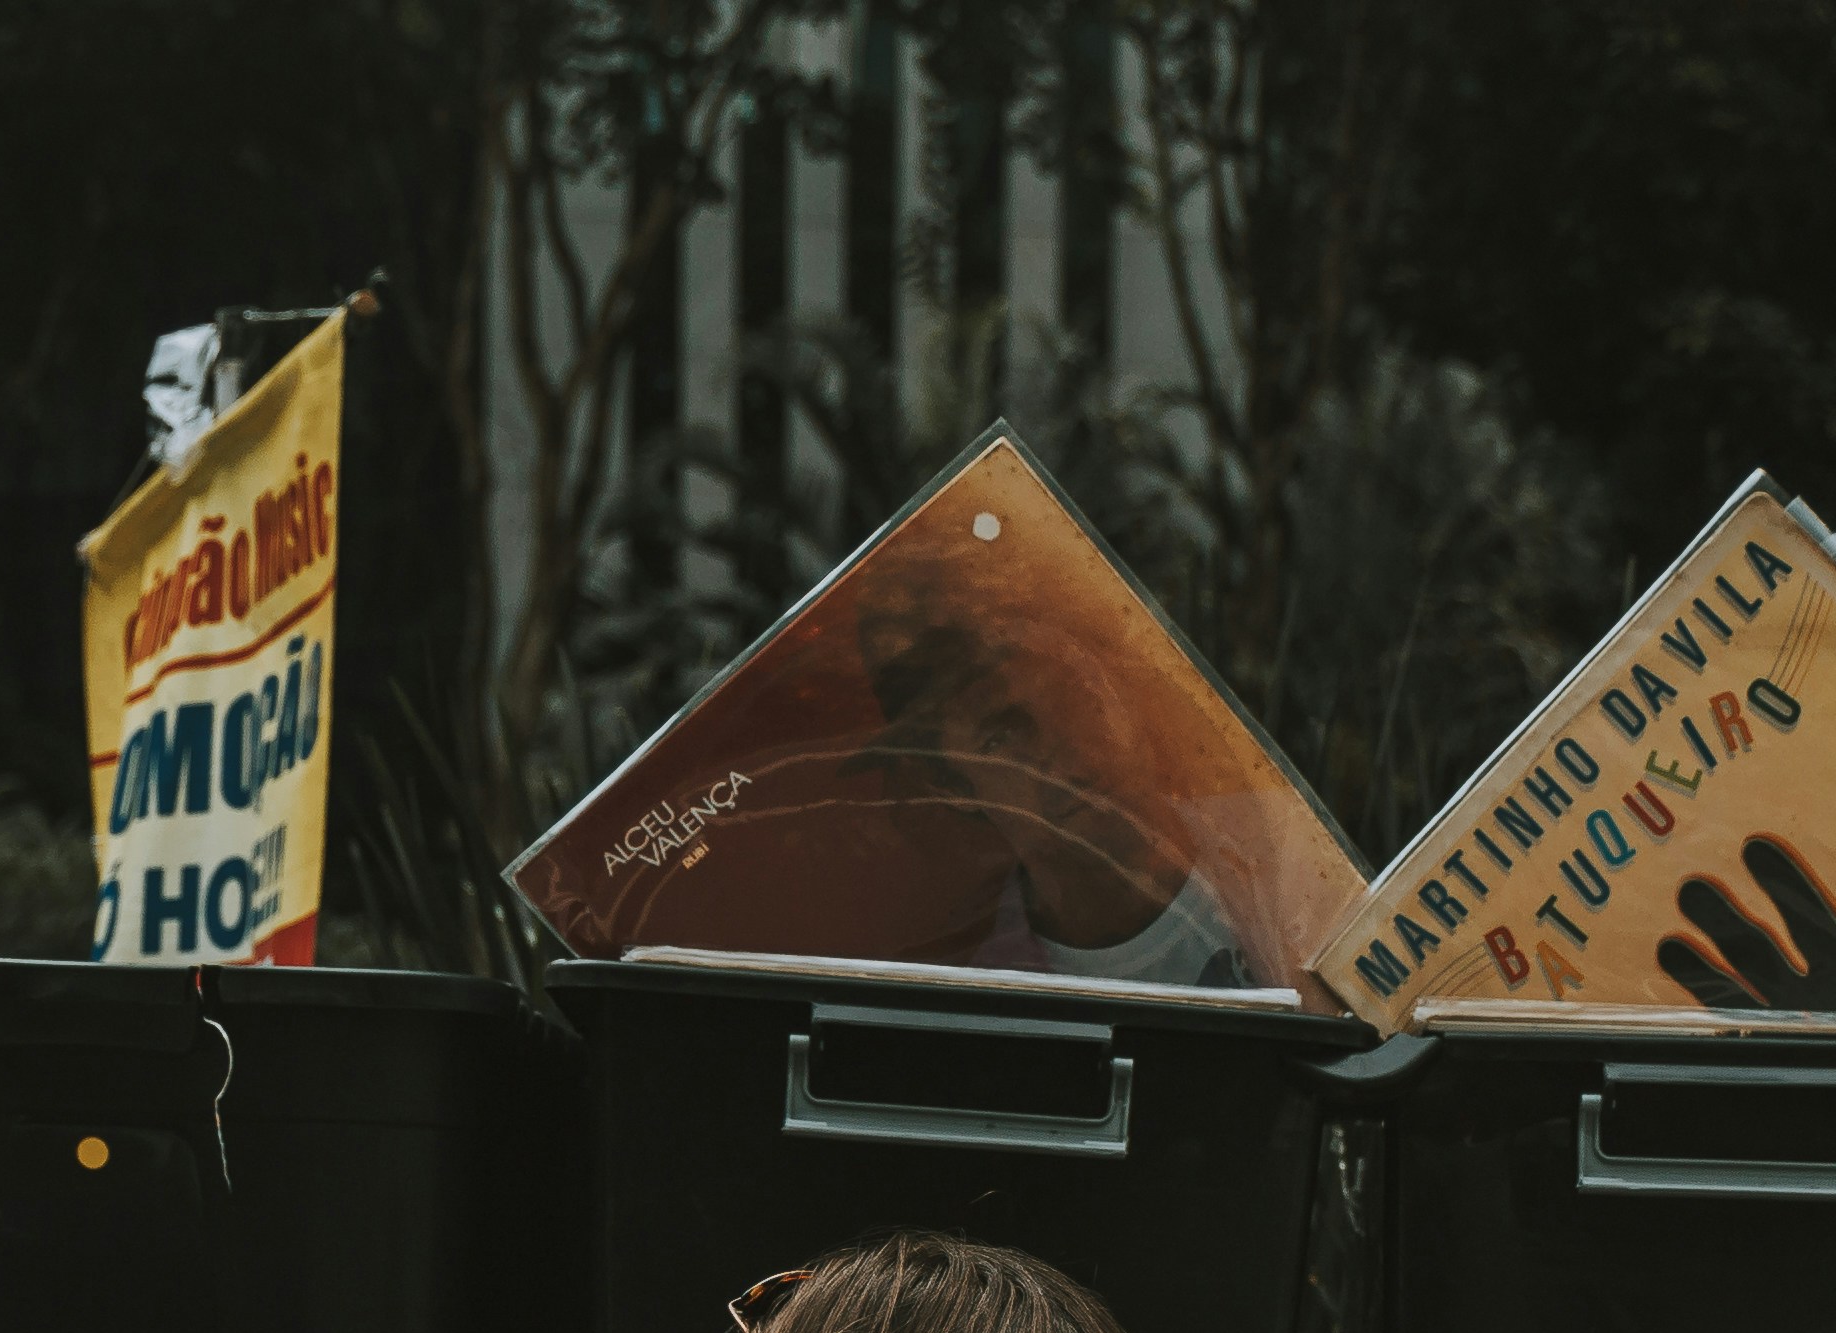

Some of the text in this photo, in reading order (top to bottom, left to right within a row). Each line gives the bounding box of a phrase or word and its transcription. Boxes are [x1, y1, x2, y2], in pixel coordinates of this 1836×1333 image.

[602, 800, 676, 877] ALCEU
[638, 771, 753, 867] VALENÇA
[1354, 540, 1794, 999] MARTINHO DA VILA
[1484, 676, 1803, 999] BATUQUEIRO
